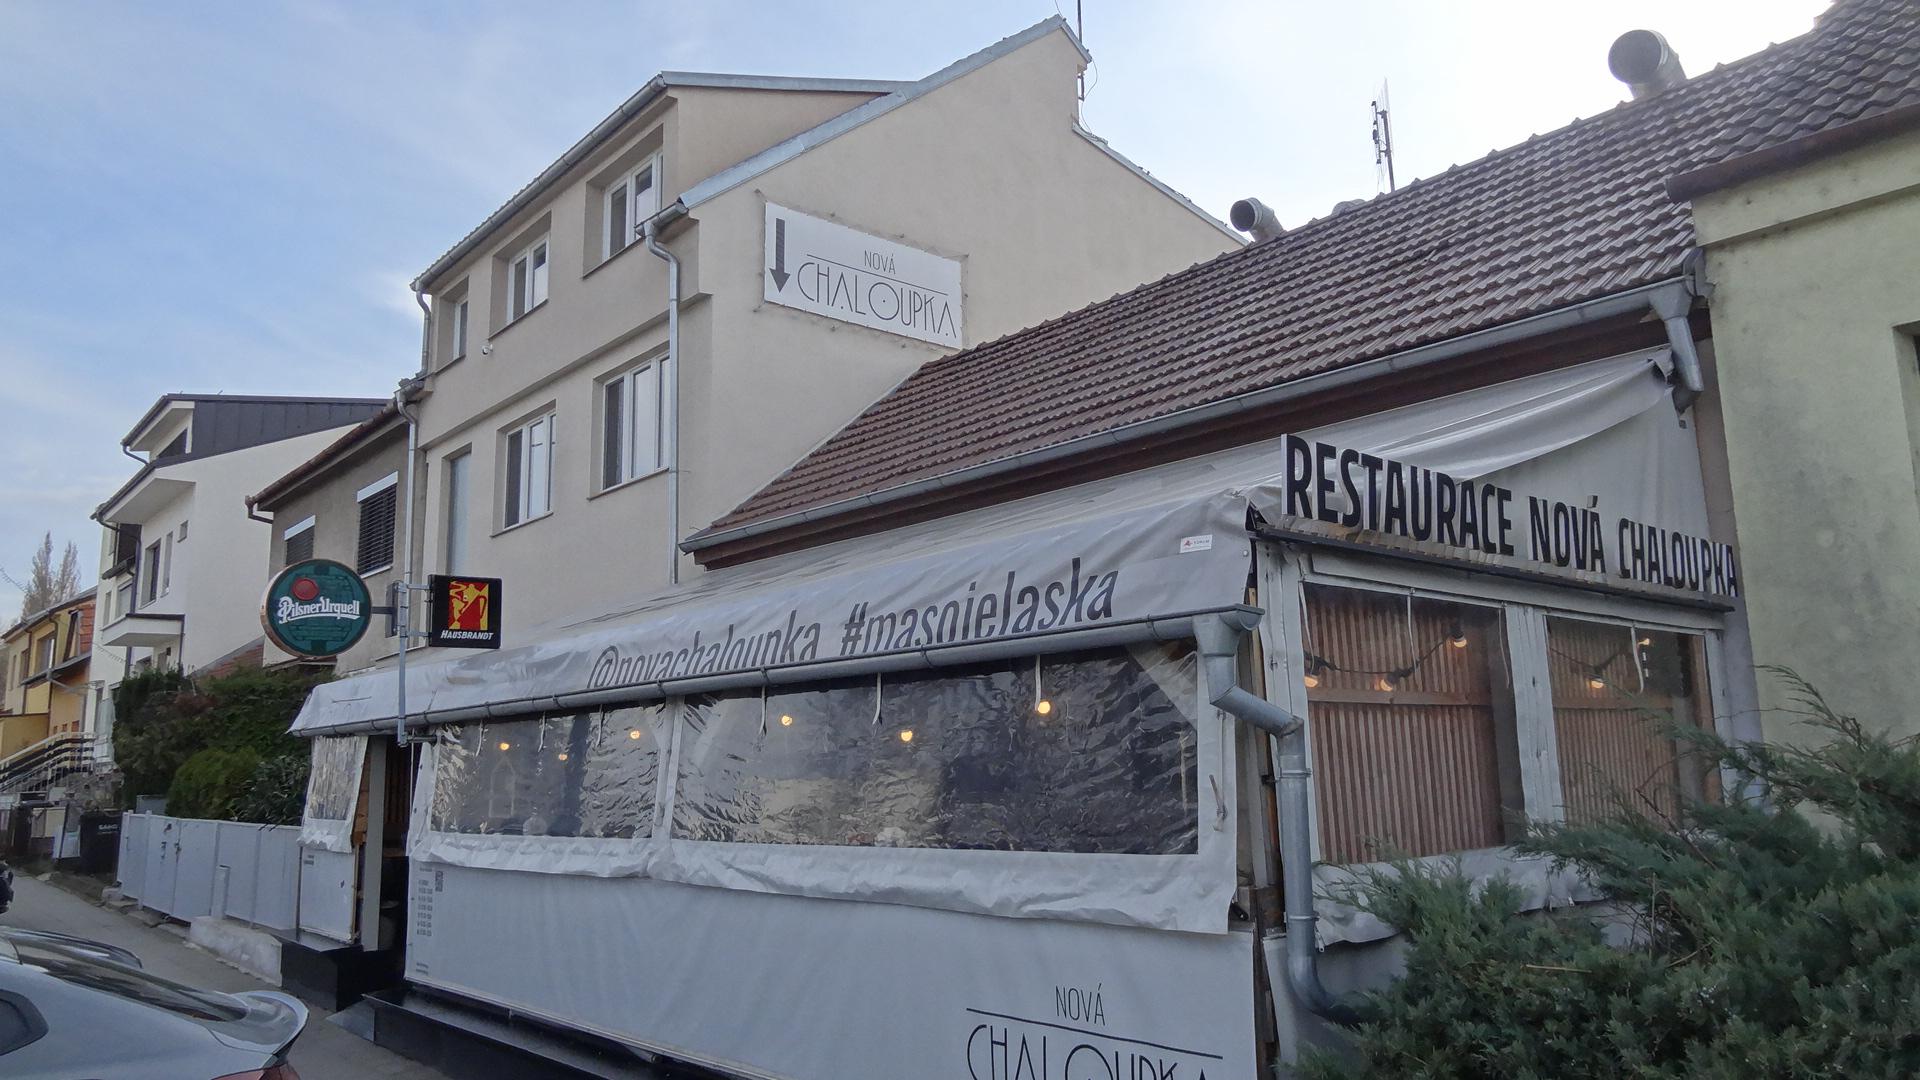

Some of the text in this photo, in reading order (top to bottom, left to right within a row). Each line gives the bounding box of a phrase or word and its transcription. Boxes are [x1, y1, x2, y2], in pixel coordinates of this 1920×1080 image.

[864, 250, 896, 275] NOVÁ
[797, 262, 957, 339] CHALOUPKA
[1280, 433, 1739, 598] RESTAURACE NOVÁ CHALOUPKA
[277, 595, 360, 624] Pilsner Urquell
[440, 629, 494, 641] HAUSBRANDT
[1055, 983, 1105, 1026] NOVÁ
